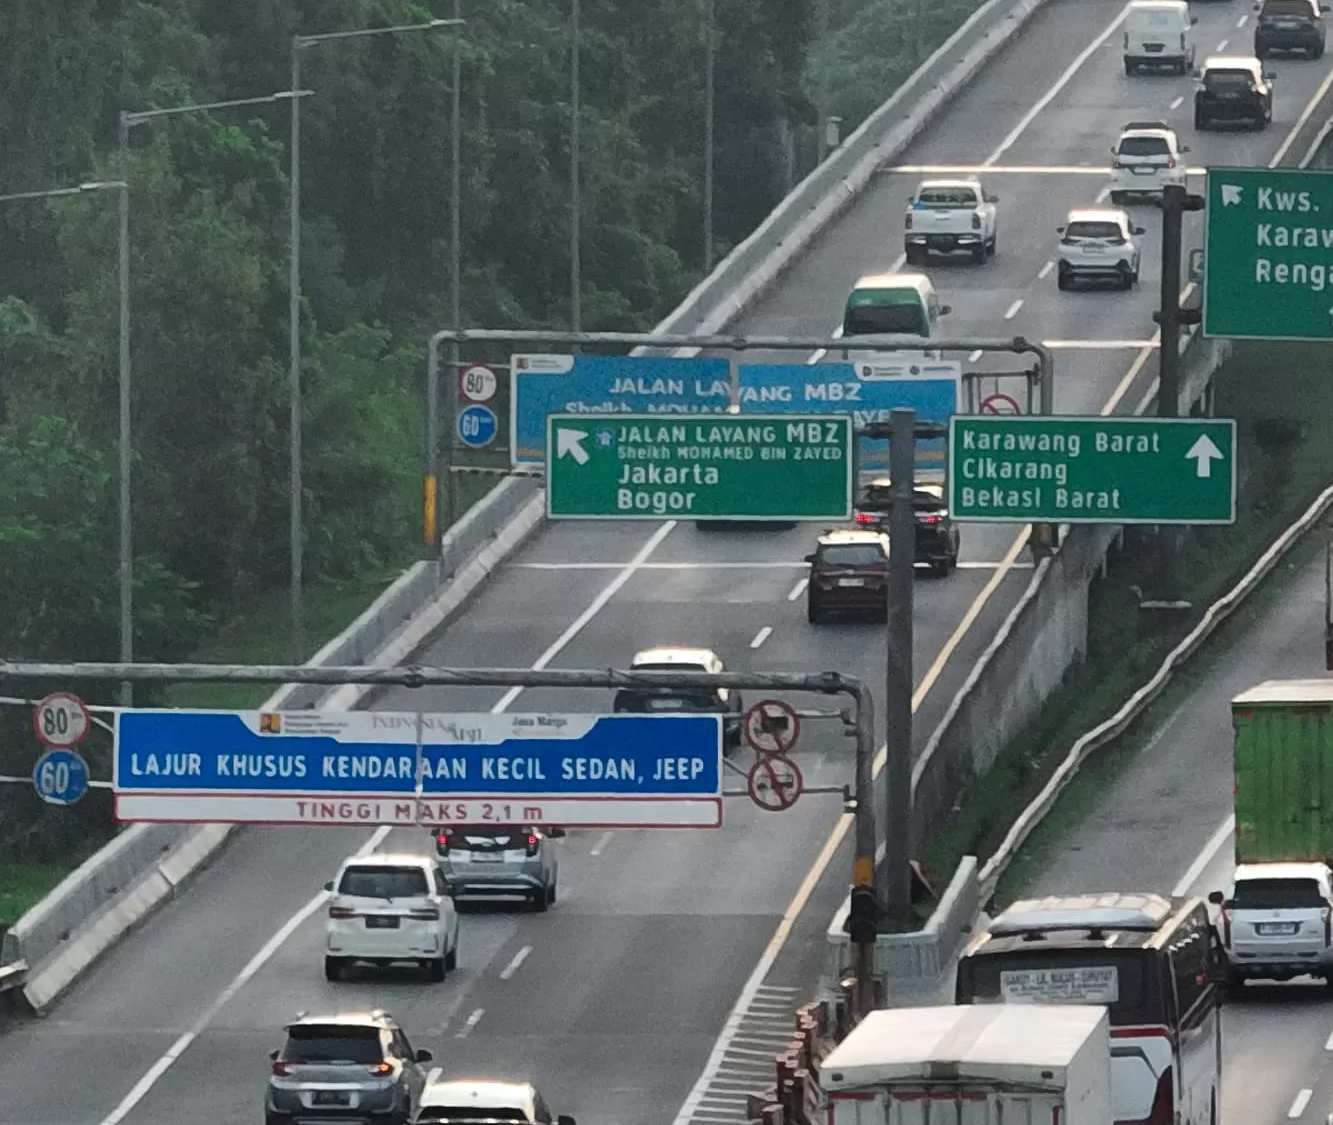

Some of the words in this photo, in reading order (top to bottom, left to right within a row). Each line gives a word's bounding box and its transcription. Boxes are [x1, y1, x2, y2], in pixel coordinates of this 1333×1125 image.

[1257, 187, 1320, 212] Kws.
[466, 373, 484, 395] 80
[609, 377, 684, 396] JALAN
[805, 382, 863, 401] MBZ
[462, 414, 480, 437] 60
[617, 425, 686, 444] JALAN
[695, 425, 777, 444] LAYANG
[786, 422, 840, 444] MBZ
[616, 446, 671, 460] Sheikh
[677, 446, 754, 460] MOHAMED
[761, 446, 786, 460] BIN
[793, 446, 842, 460] ZAYED
[962, 430, 1080, 456] Karawang
[1094, 432, 1161, 454] Barat
[617, 463, 720, 485] Jakarta
[962, 458, 1067, 484] Cikarang
[616, 488, 696, 513] Bogor
[961, 486, 1041, 509] Bekasi
[1055, 488, 1121, 510] Barat
[44, 707, 69, 736] 80
[41, 761, 69, 795] 60
[131, 753, 200, 776] LAJUR
[217, 755, 306, 778] KHUSUS
[322, 756, 467, 780] KENDARAAN
[481, 757, 546, 780] KECIL
[561, 758, 645, 784] SEDAN,
[653, 758, 705, 781] JEEP
[296, 801, 381, 820] TINGGI
[395, 804, 468, 821] MAKS
[482, 804, 512, 823] 2,1
[524, 806, 543, 820] m
